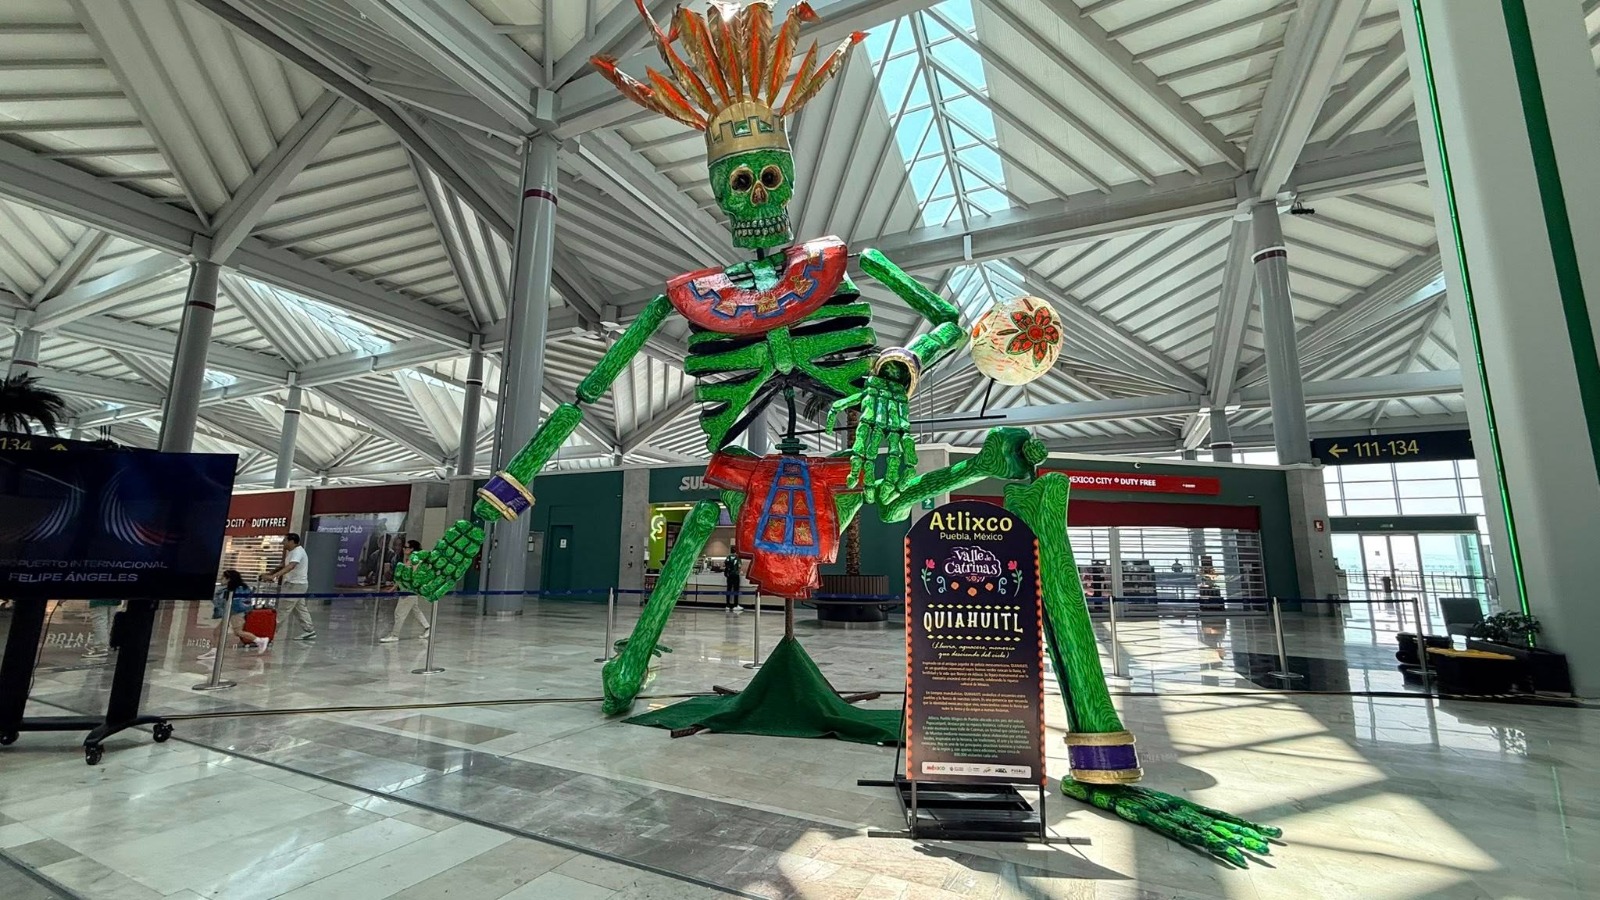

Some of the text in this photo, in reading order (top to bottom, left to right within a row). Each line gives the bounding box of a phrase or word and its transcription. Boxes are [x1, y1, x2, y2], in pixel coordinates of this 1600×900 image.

[1353, 440, 1420, 457] 111-134
[230, 519, 246, 528] CITY
[251, 519, 270, 528] DUTY
[270, 517, 287, 527] FREE
[929, 511, 1013, 532] Atlixco
[350, 525, 363, 534] Club
[940, 531, 1003, 541] Puebla, México
[954, 549, 984, 563] Valle
[70, 560, 169, 569] INTERNACIONAL
[944, 561, 998, 575] Catrinas
[8, 571, 139, 583] FELIPE ÁNGELES
[923, 611, 1024, 634] QUIAHUITL
[938, 651, 950, 659] que
